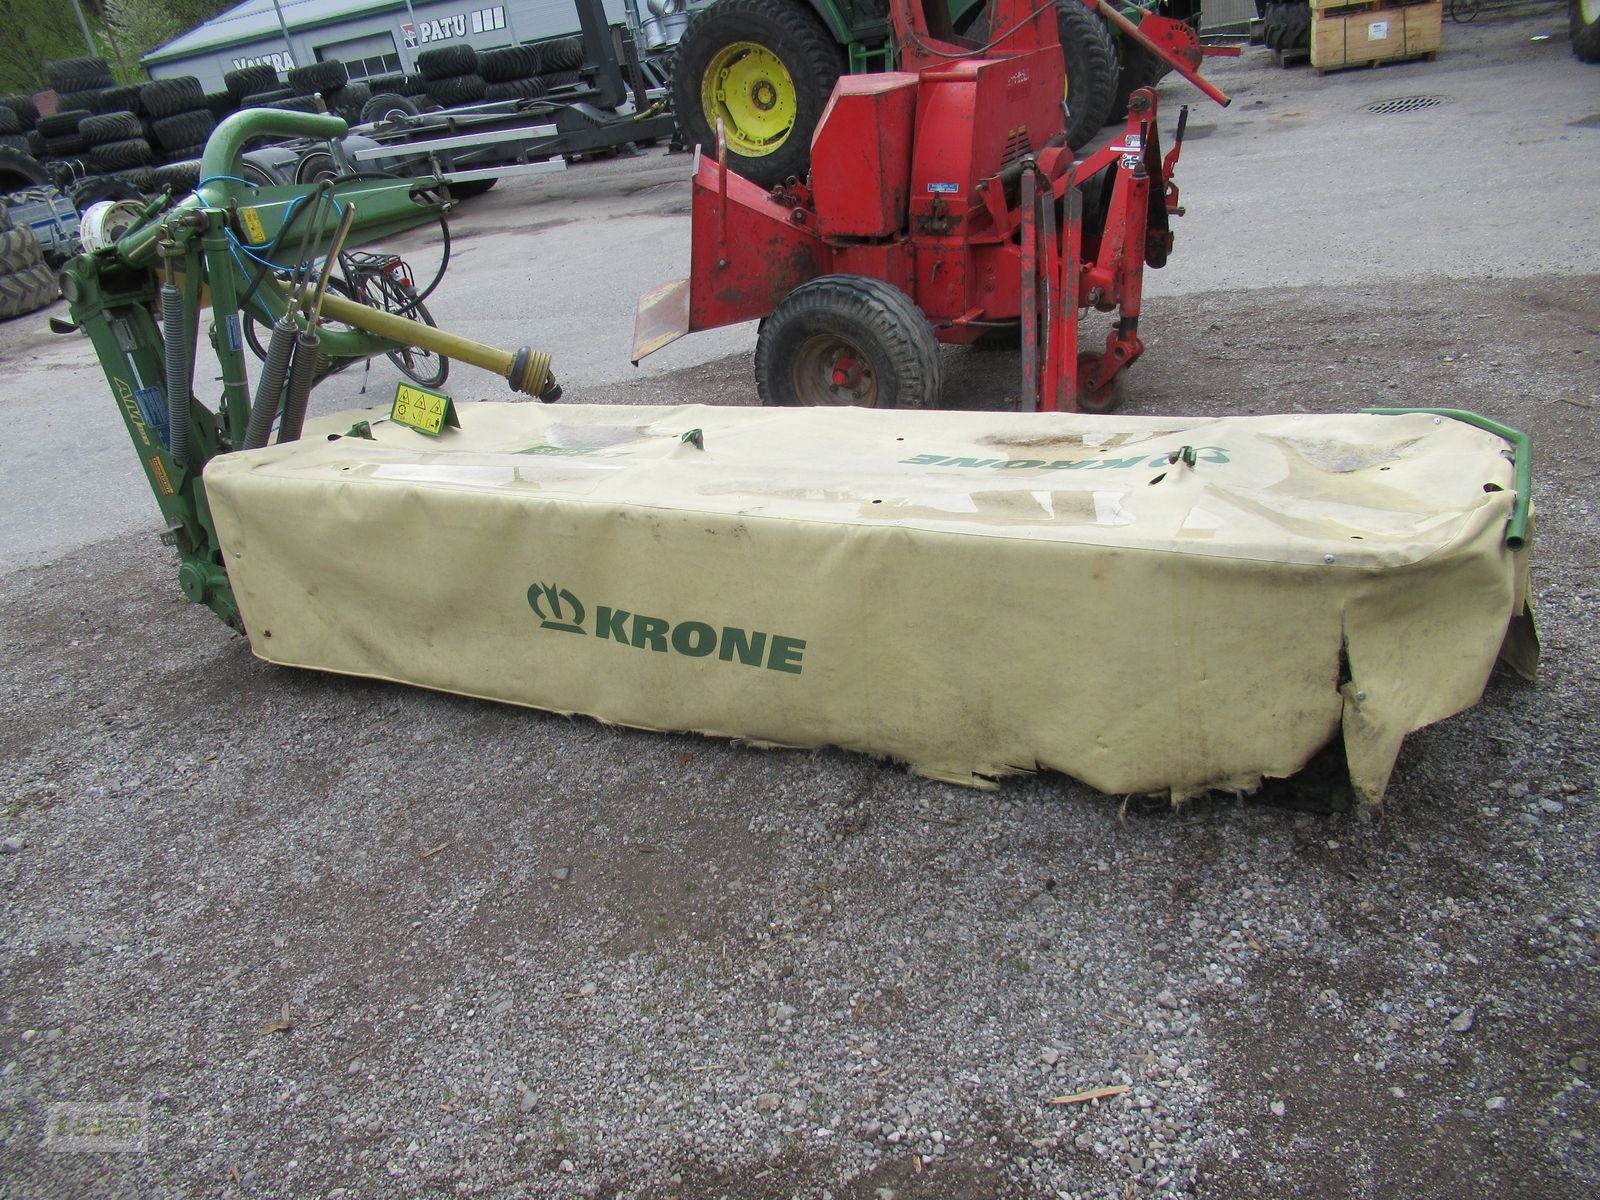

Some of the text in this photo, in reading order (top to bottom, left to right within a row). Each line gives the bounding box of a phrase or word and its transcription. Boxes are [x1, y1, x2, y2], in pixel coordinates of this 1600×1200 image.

[419, 14, 467, 43] PATU
[897, 454, 1150, 470] KRONE
[596, 605, 807, 675] KRONE
